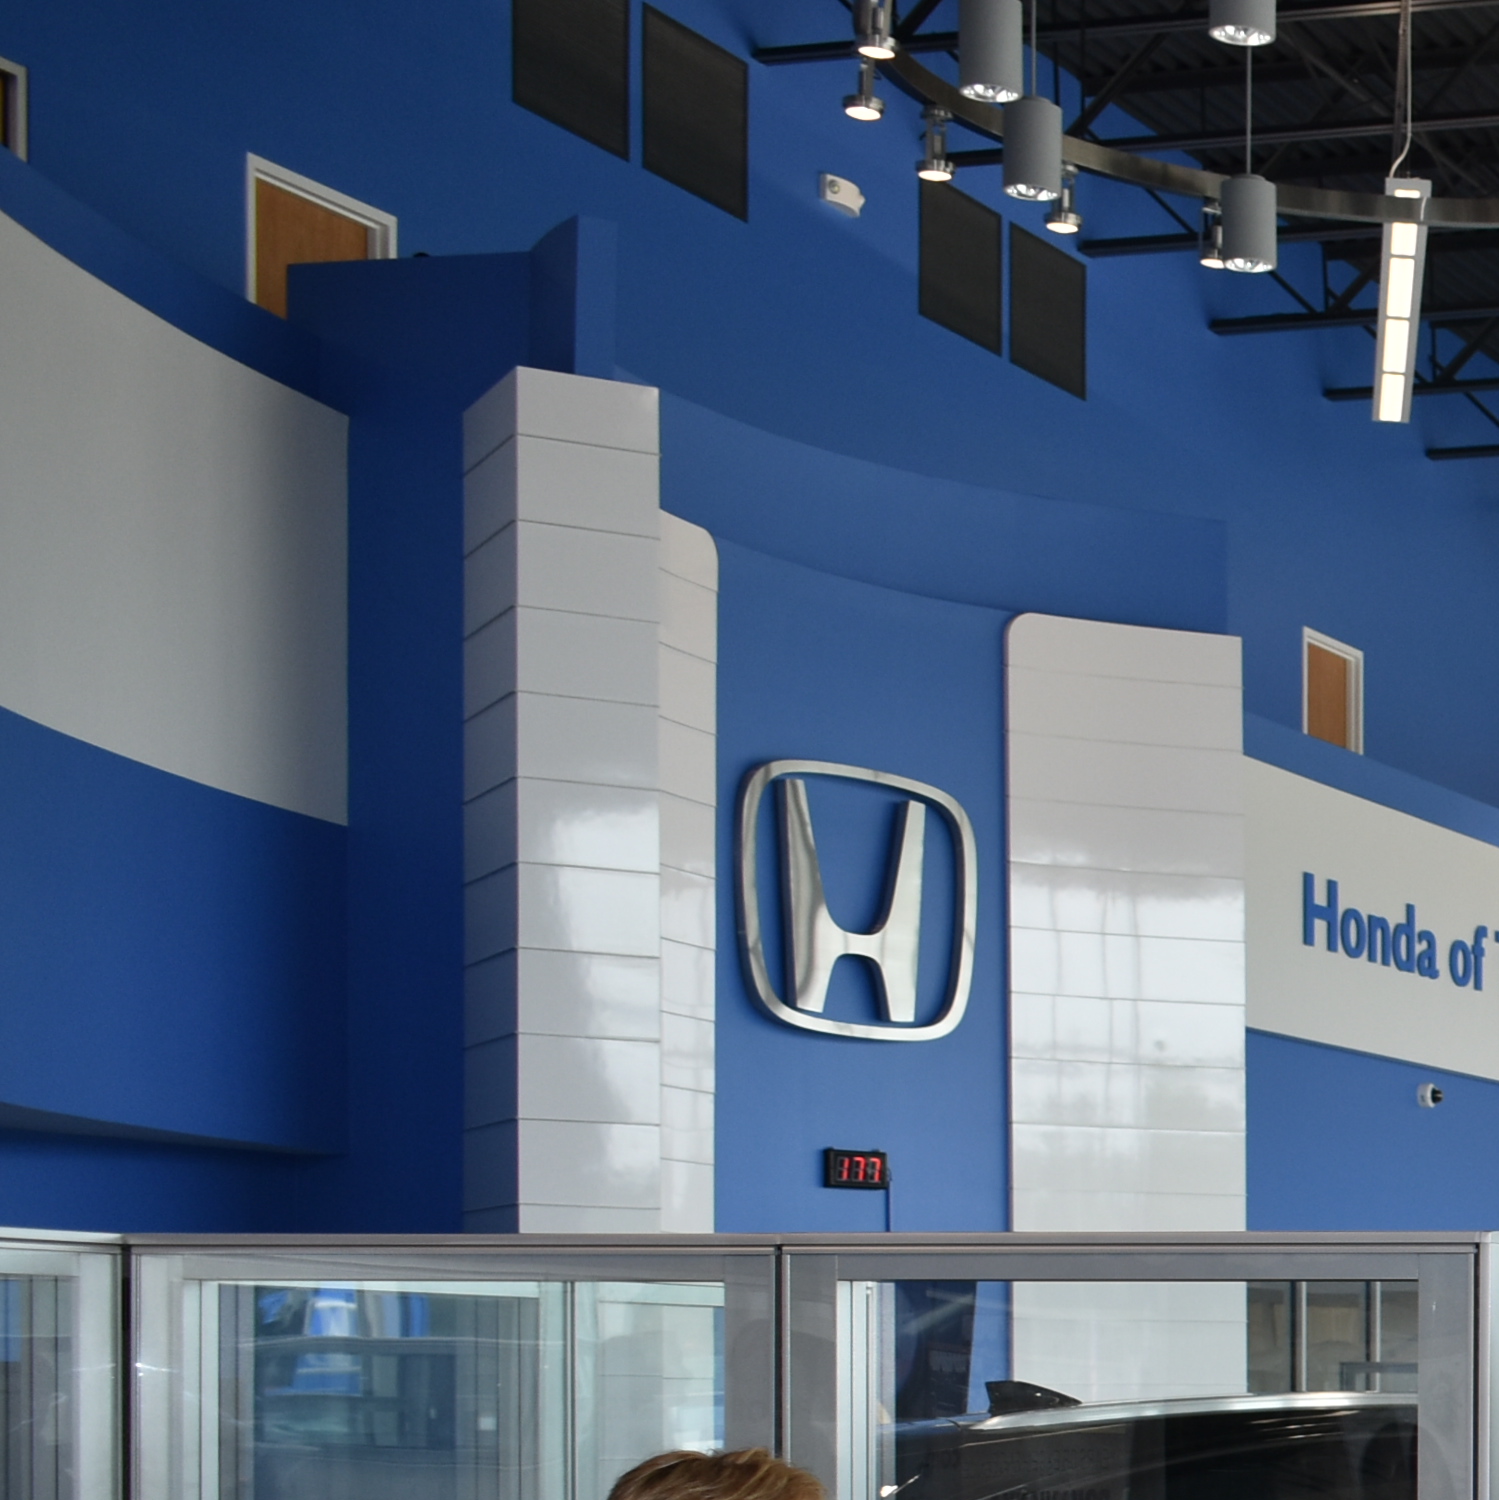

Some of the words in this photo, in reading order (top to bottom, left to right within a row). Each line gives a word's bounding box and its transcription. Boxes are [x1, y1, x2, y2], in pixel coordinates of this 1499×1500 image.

[1302, 871, 1440, 980] Honda
[1449, 925, 1488, 991] of
[842, 1156, 882, 1183] 177
